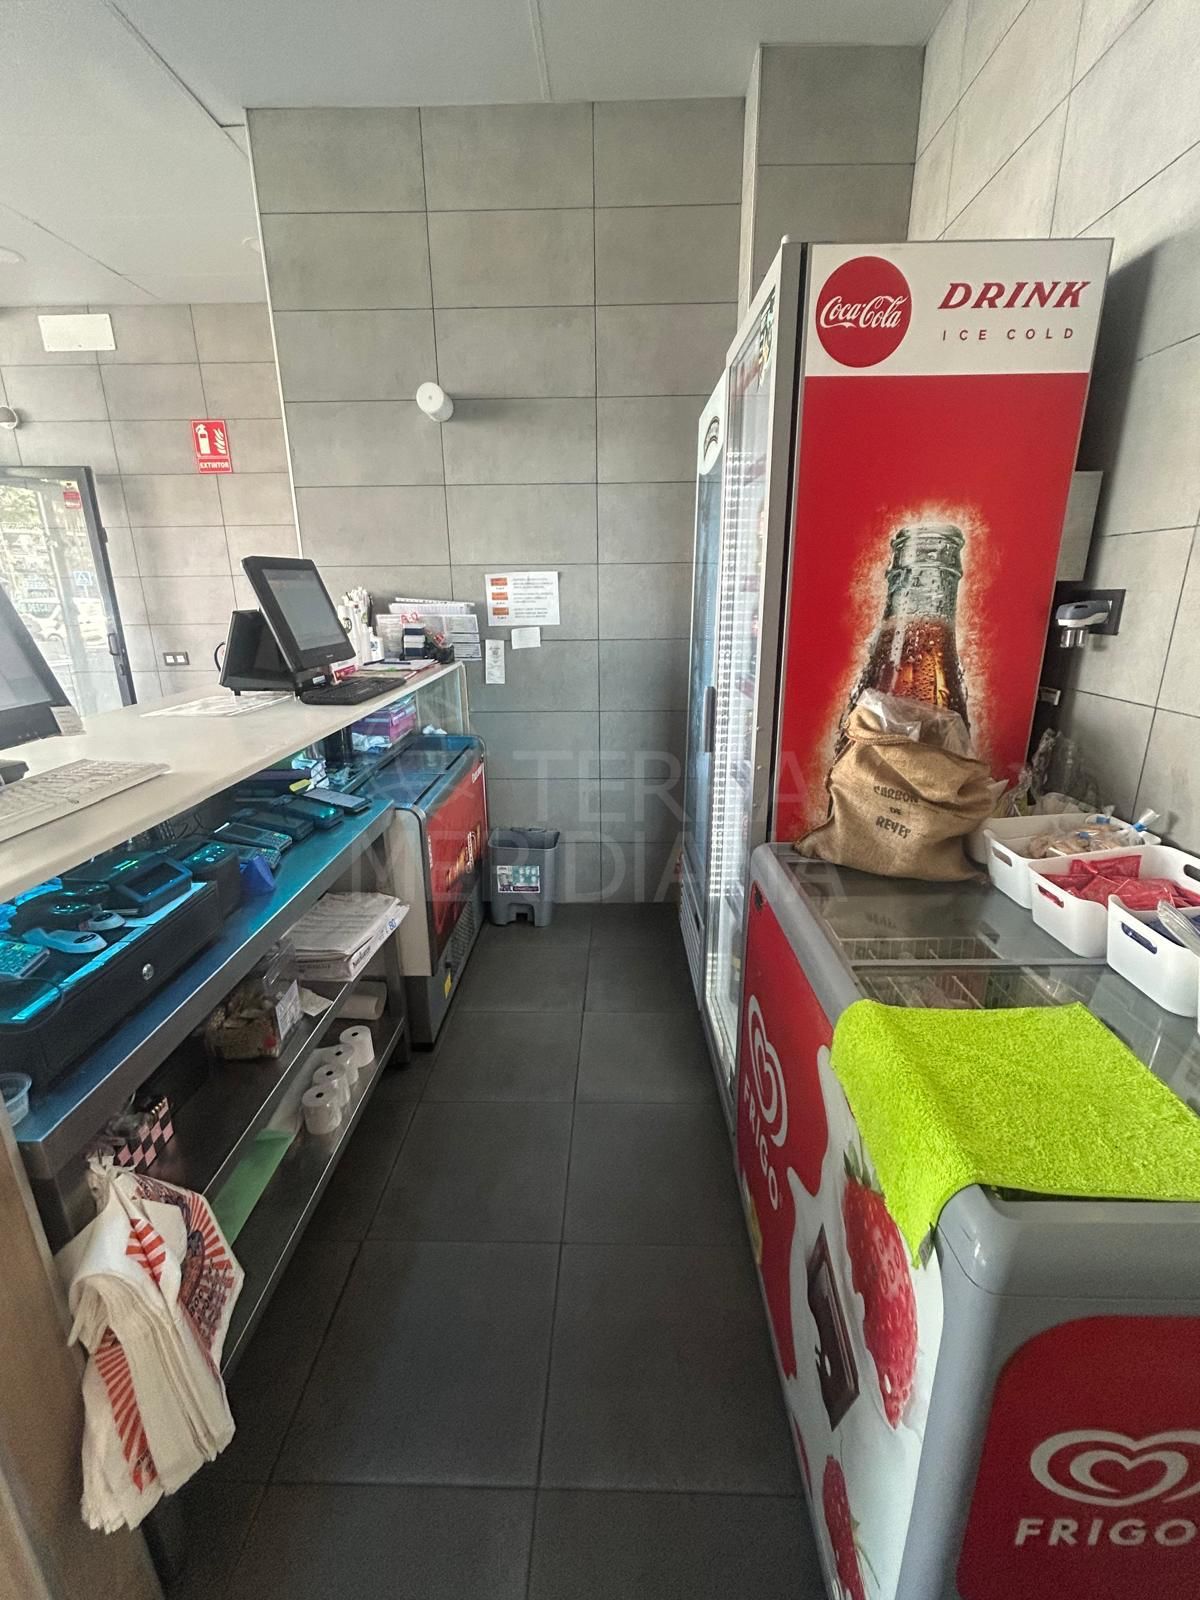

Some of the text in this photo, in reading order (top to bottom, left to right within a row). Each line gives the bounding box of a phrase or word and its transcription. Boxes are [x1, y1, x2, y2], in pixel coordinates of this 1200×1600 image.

[937, 280, 1091, 310] DRINK
[820, 295, 909, 329] Coca-Cola
[941, 327, 1075, 341] ICE COLD
[875, 815, 912, 839] REYES
[743, 1072, 779, 1211] FRIGO
[1014, 1517, 1197, 1547] FRIGO
